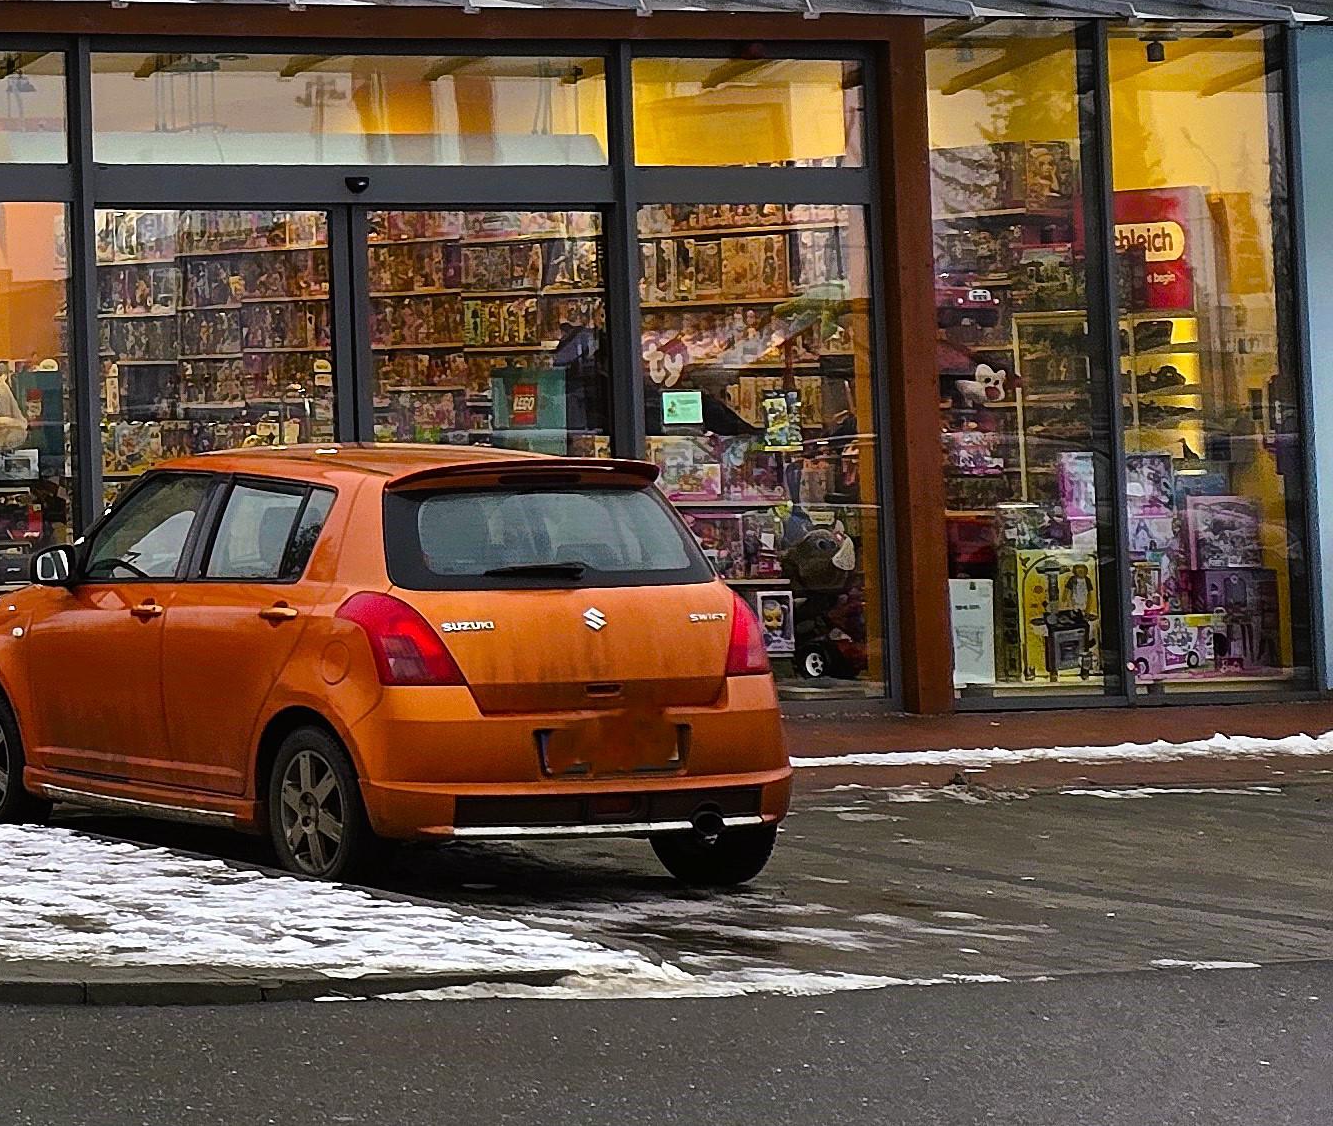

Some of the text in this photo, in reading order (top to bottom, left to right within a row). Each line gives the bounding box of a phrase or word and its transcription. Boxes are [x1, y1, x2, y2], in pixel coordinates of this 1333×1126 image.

[642, 343, 684, 388] ty
[513, 395, 535, 412] LEGO
[689, 612, 727, 622] SWIFT
[441, 621, 495, 632] SUZUKI
